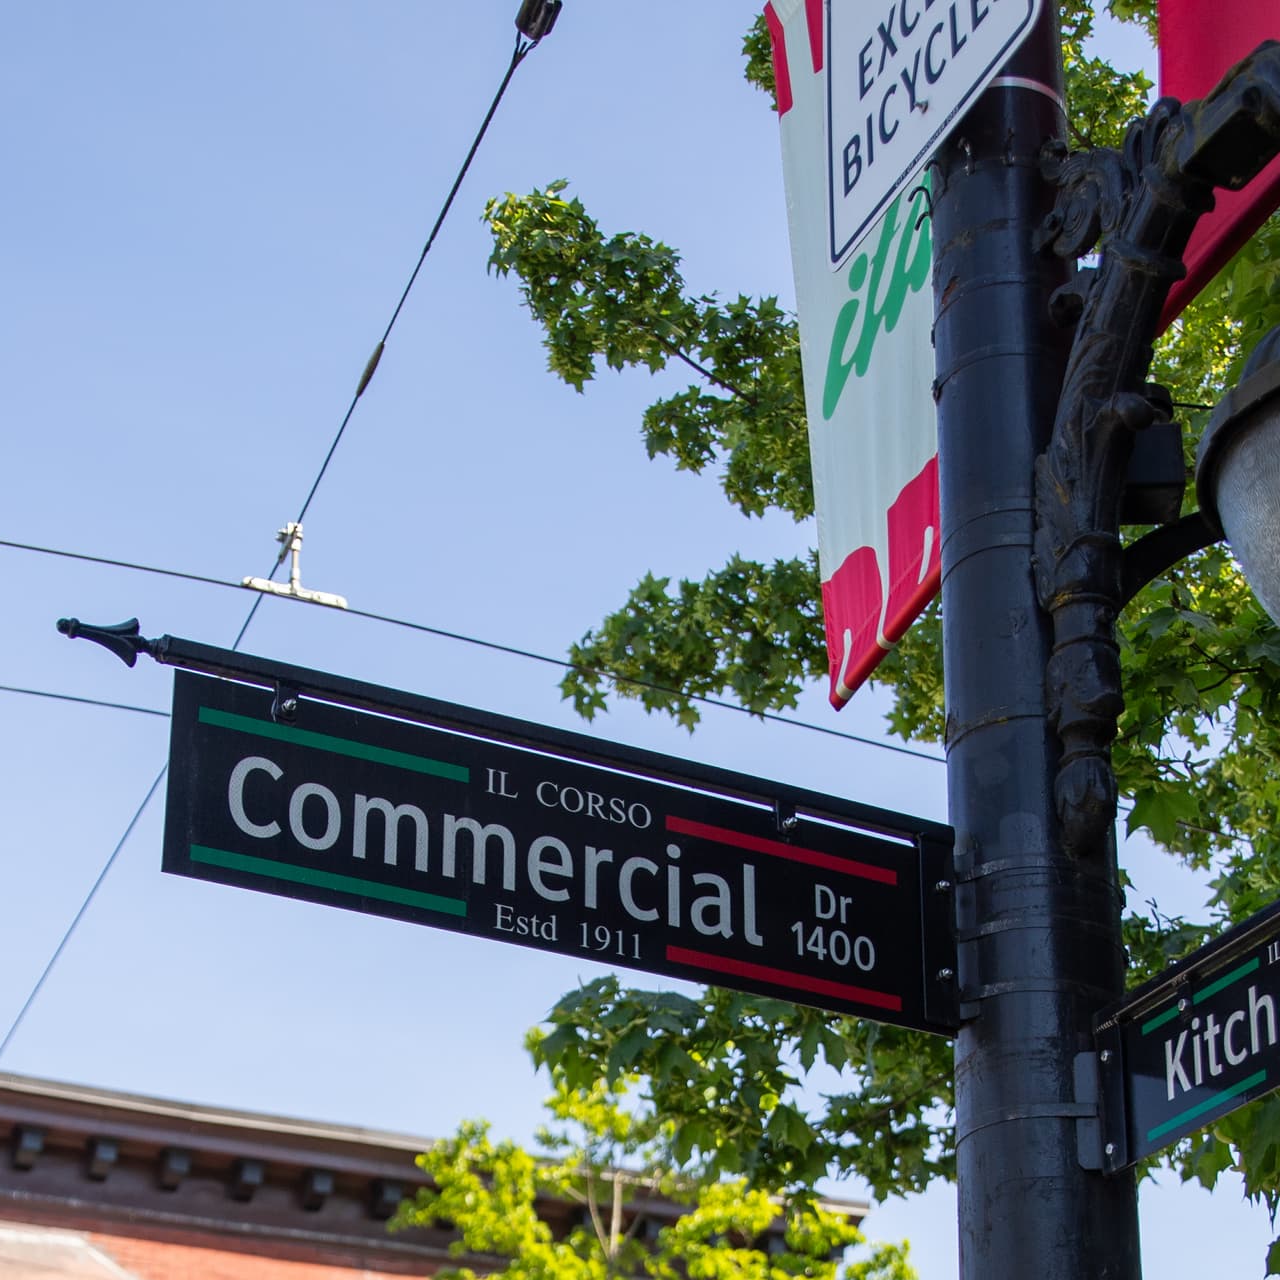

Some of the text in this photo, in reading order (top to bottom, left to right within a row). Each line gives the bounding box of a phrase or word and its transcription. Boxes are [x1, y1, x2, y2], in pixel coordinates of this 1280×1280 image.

[842, 0, 1002, 198] BICYCLE
[483, 767, 653, 830] IL CORSO
[227, 755, 765, 948] Commercial
[493, 902, 643, 960] Estd 1911
[813, 883, 853, 925] Dr
[789, 920, 877, 973] 1400
